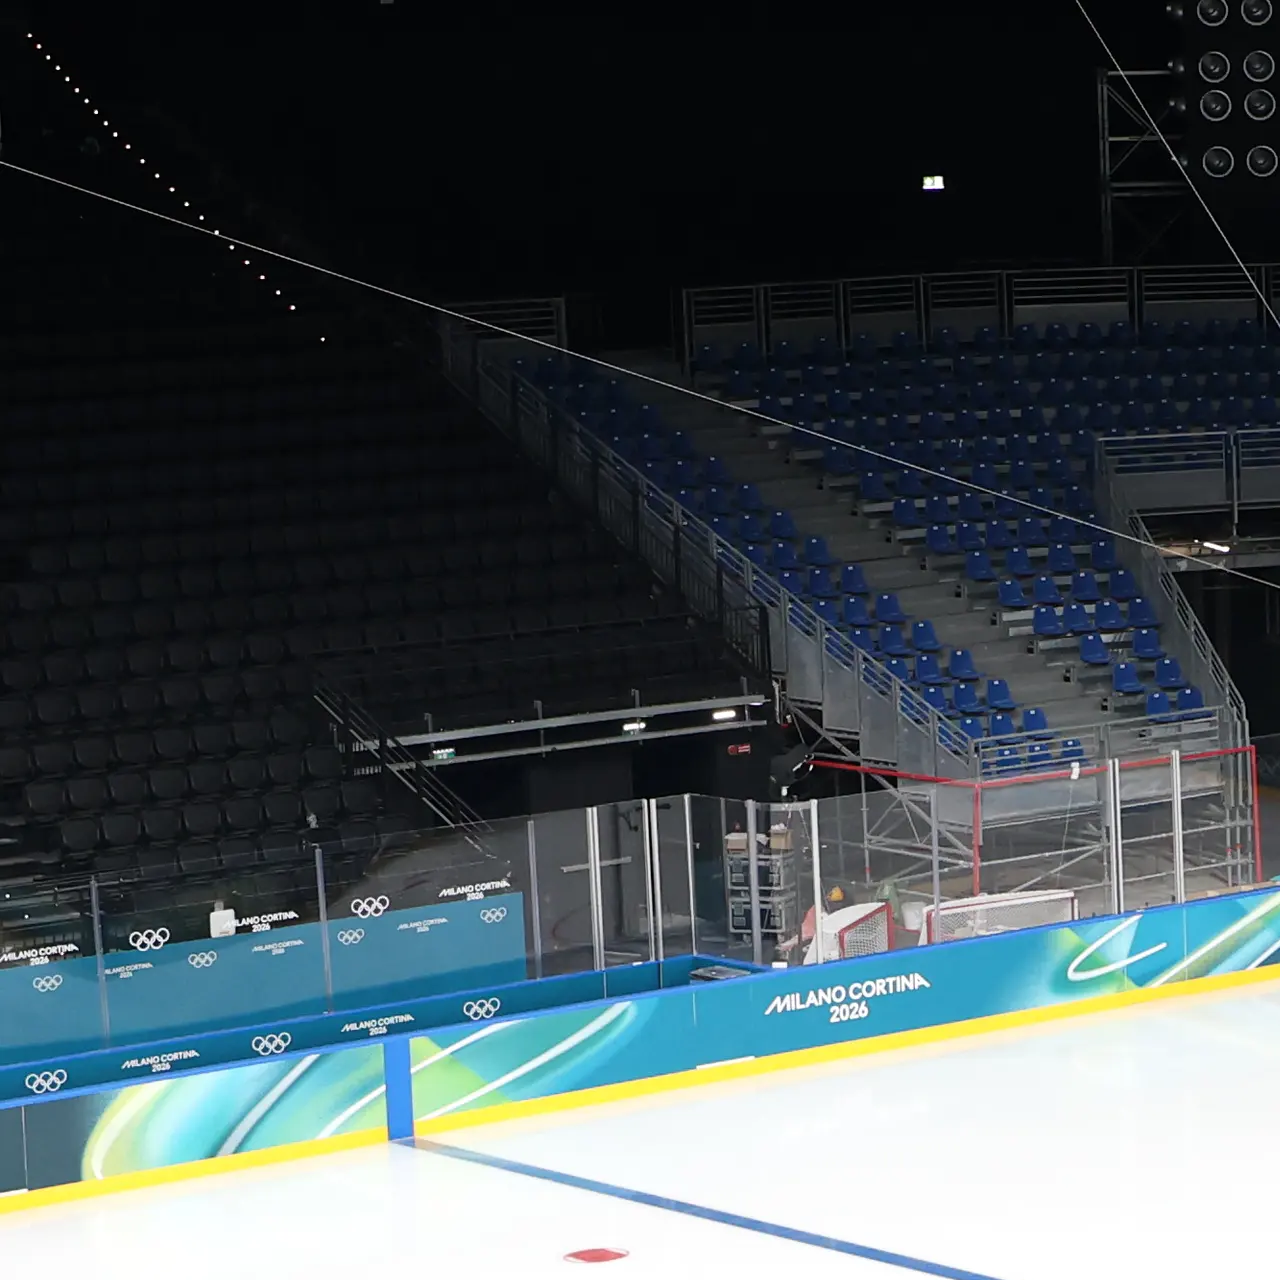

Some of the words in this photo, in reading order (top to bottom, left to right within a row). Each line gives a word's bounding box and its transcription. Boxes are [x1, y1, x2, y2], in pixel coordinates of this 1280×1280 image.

[438, 884, 474, 898] MILANO
[475, 879, 511, 892] CORTINA
[466, 892, 485, 902] 2026
[260, 910, 300, 923] CORTINA
[251, 923, 271, 933] 2026
[0, 948, 38, 963] MILANO
[38, 942, 80, 956] CORTINA
[29, 955, 50, 966] 2026
[763, 985, 847, 1016] MILANO
[848, 972, 932, 1000] CORTINA
[829, 999, 870, 1024] 2026
[341, 1019, 378, 1033] MILANO
[377, 1013, 415, 1027] CORTINA
[369, 1025, 388, 1037] 2026
[121, 1056, 161, 1070] MILANO
[160, 1048, 201, 1062] CORTINA
[151, 1061, 172, 1073] 2026
